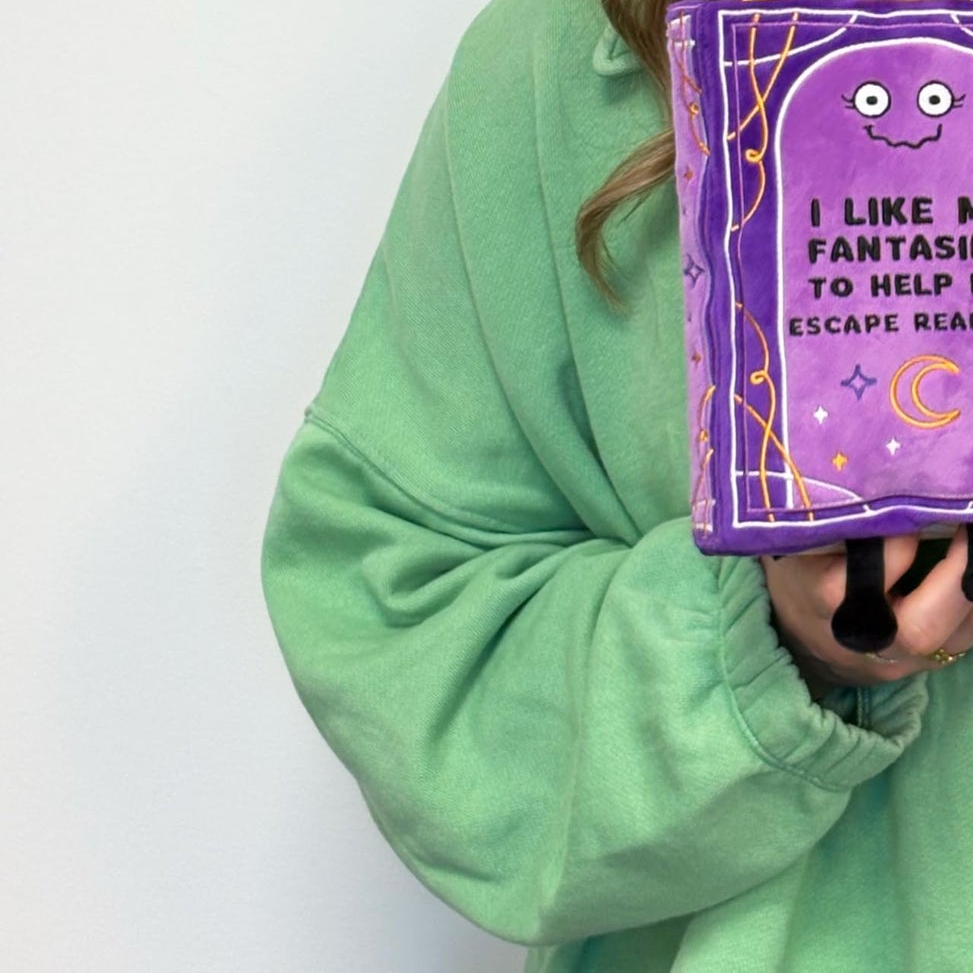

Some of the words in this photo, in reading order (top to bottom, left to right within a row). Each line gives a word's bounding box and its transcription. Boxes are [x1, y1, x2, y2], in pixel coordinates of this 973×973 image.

[811, 198, 821, 227] I
[844, 196, 934, 226] LIKE
[808, 277, 854, 300] TO
[870, 273, 953, 297] HELP
[789, 313, 899, 337] ESCAPE
